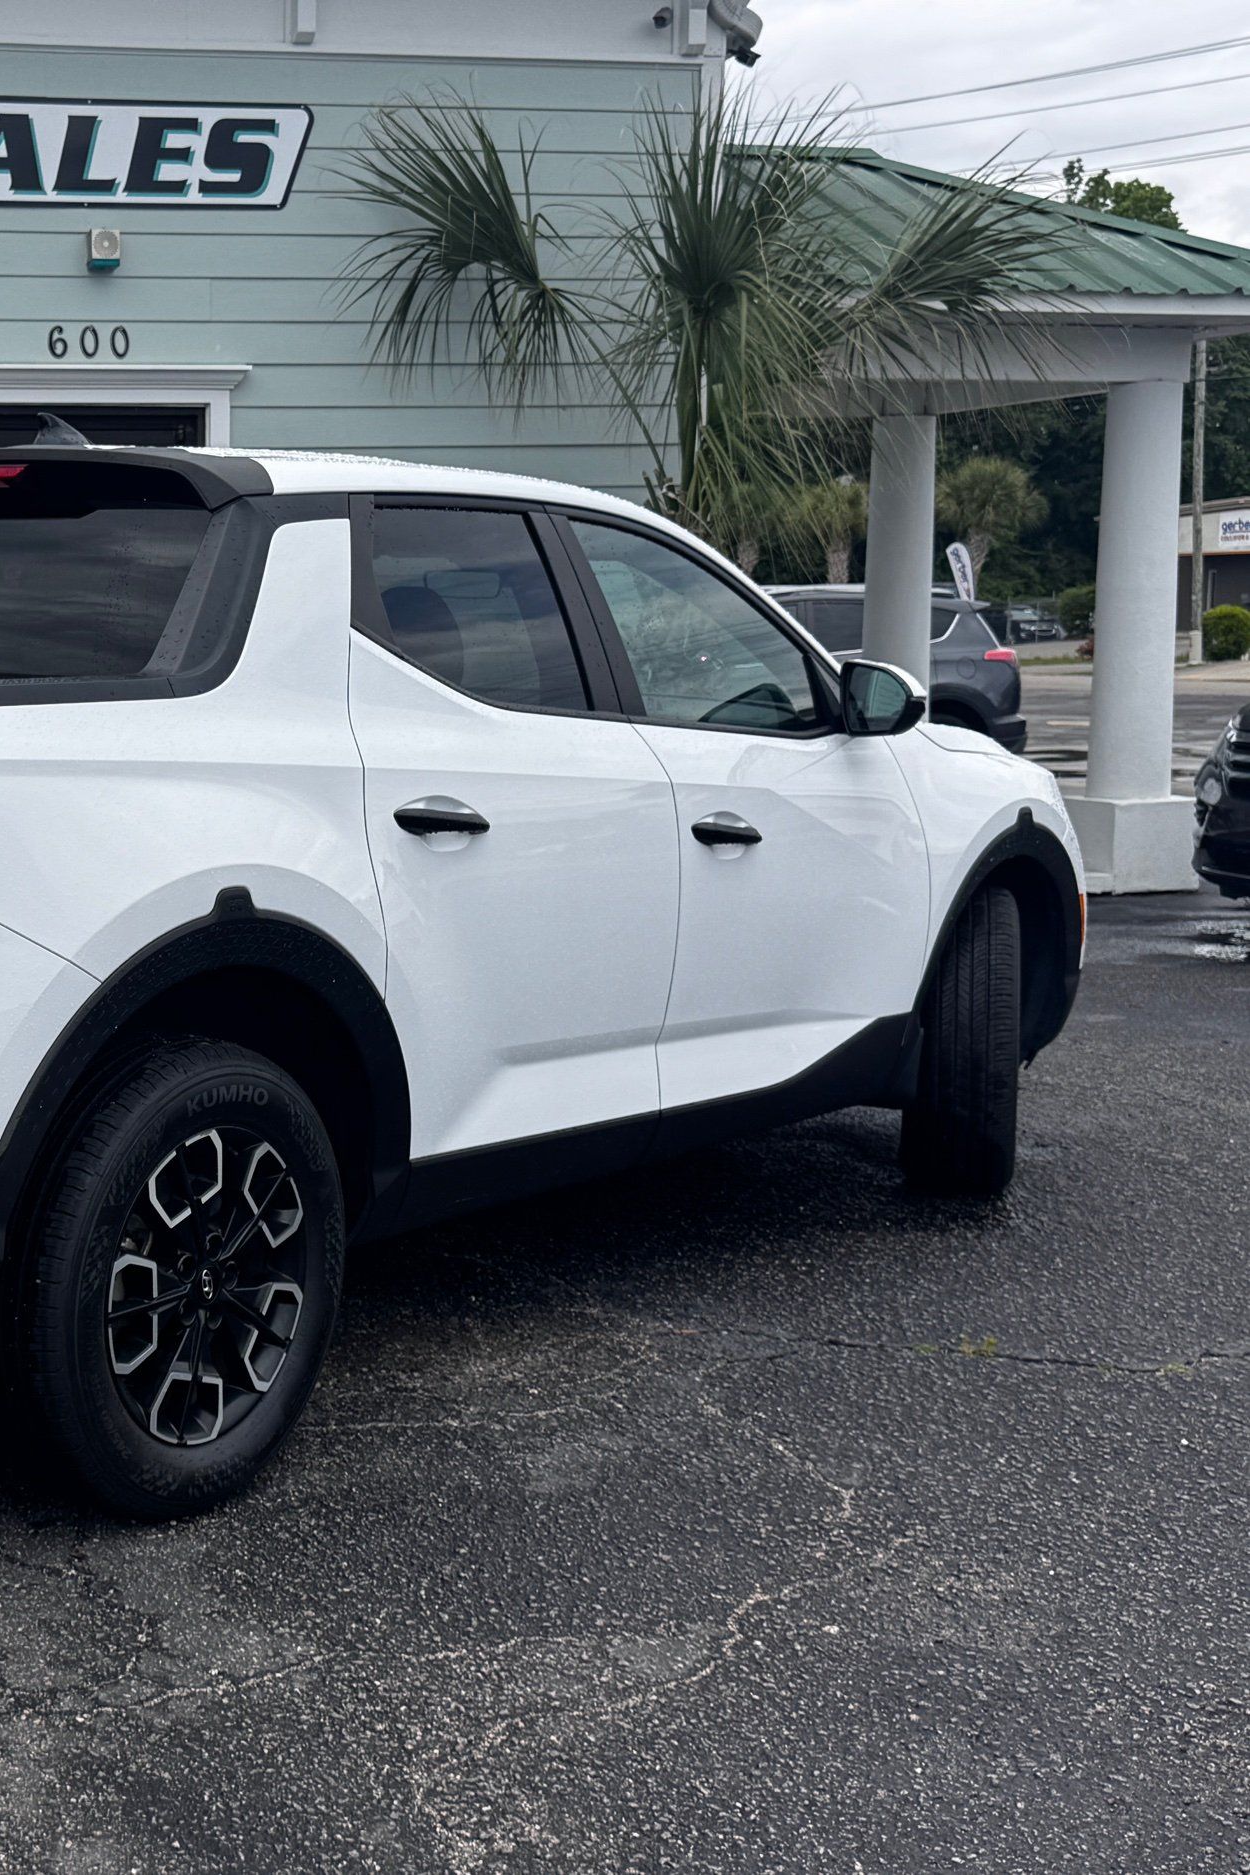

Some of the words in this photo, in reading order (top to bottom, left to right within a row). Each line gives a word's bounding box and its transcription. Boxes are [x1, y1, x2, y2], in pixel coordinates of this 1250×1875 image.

[47, 324, 131, 360] 600
[1221, 518, 1250, 535] gerbe
[186, 1083, 270, 1117] KUMHO
